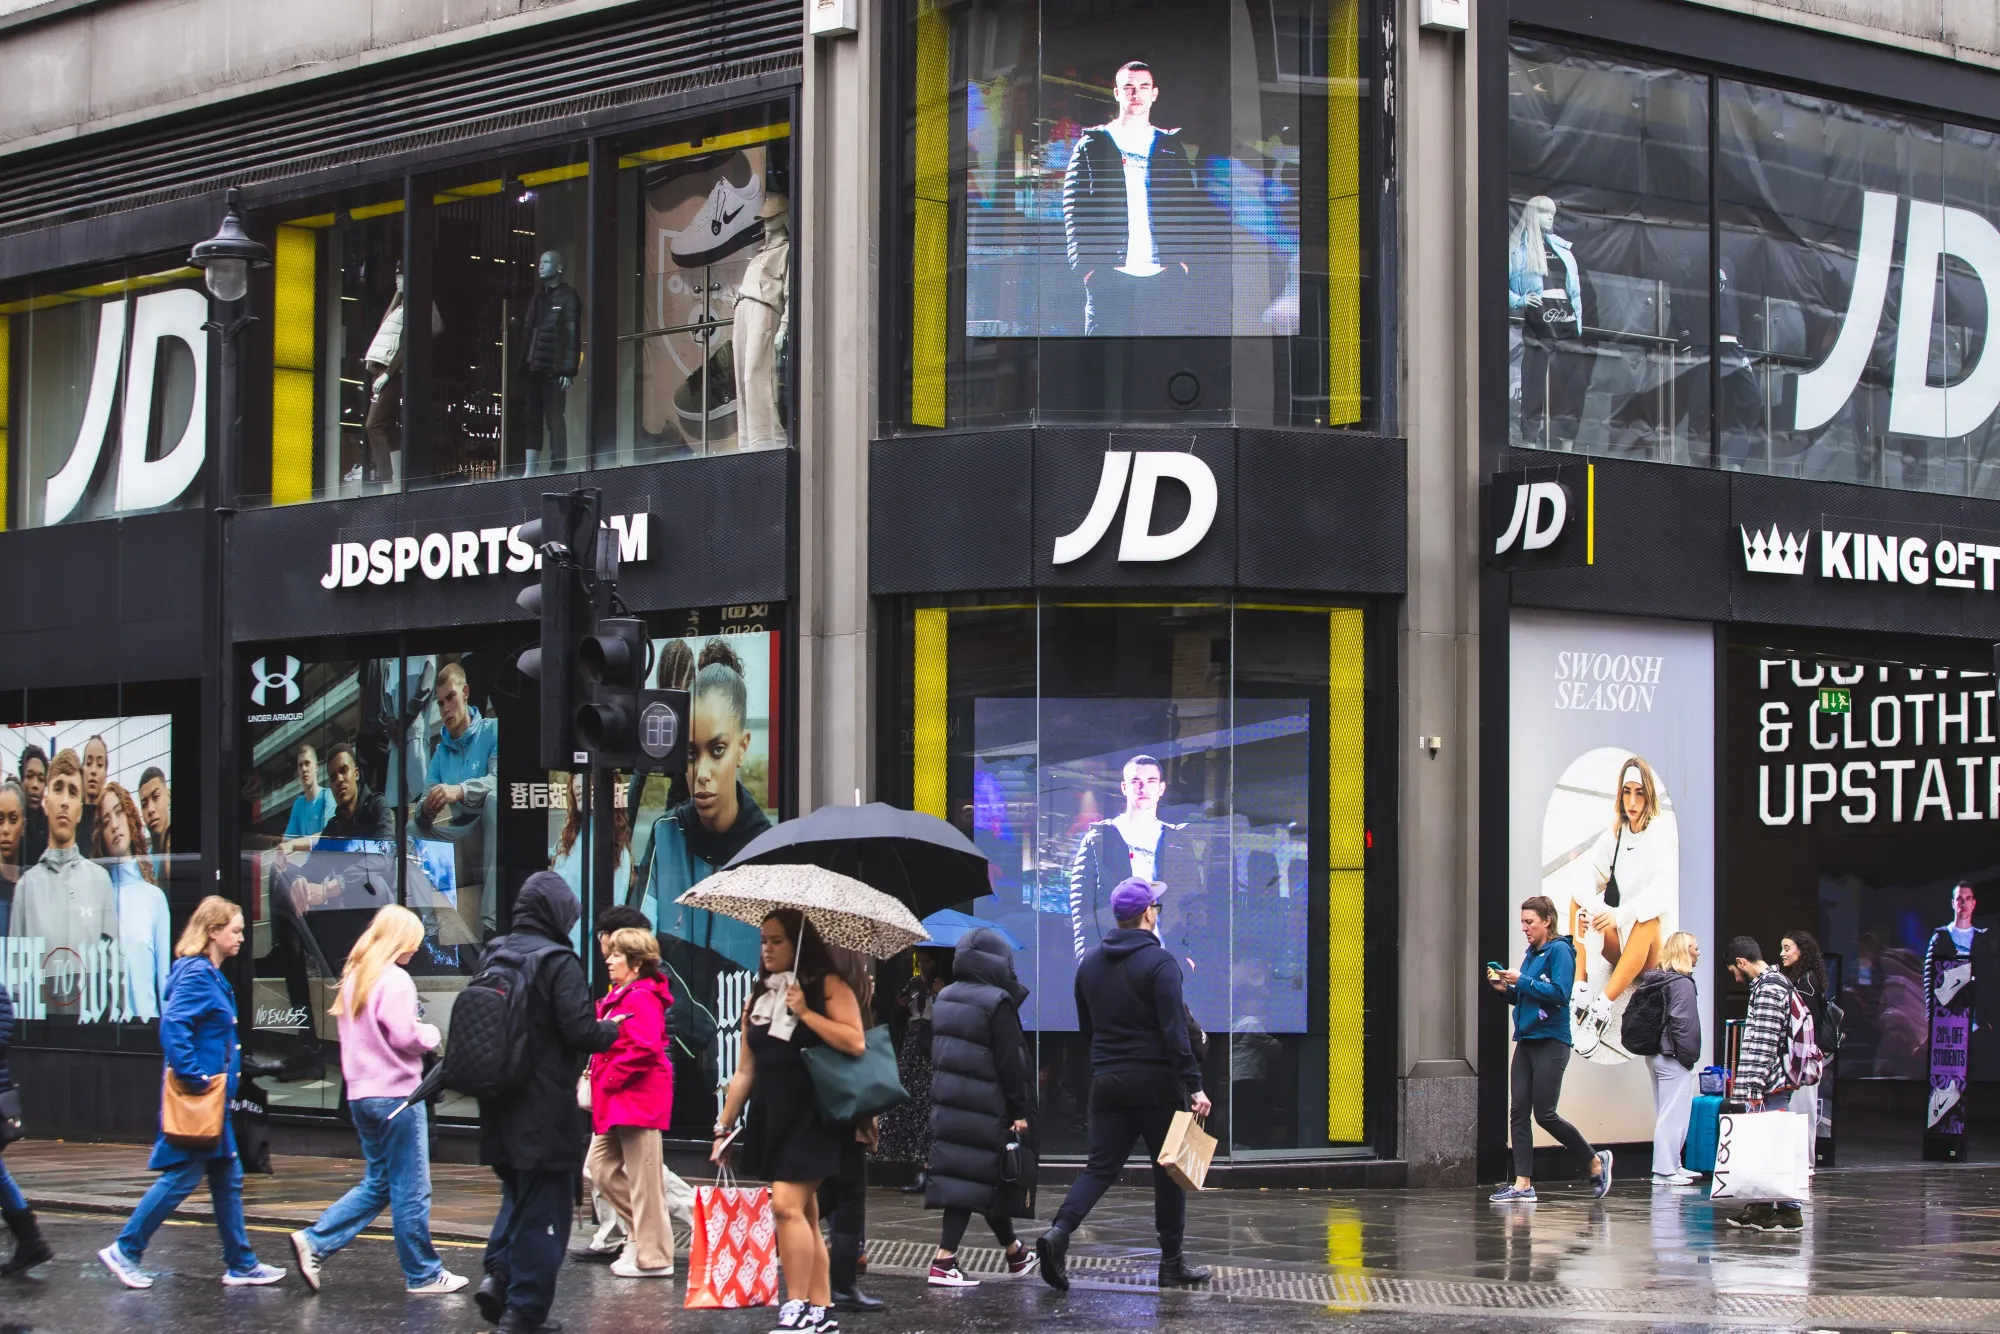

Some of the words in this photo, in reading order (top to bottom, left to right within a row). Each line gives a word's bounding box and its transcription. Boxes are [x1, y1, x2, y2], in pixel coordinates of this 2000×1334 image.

[1795, 191, 2000, 438] JD
[44, 288, 208, 526] JD
[1052, 451, 1218, 564] JD
[1495, 482, 1566, 554] JD
[320, 512, 649, 589] JDSPORTS.M
[1822, 531, 1929, 585] KING
[1935, 540, 1976, 576] OF
[1554, 651, 1664, 683] SWOOSH
[247, 715, 272, 723] UNDER
[272, 713, 304, 721] ARMOUR
[1554, 681, 1656, 712] SEASON
[1760, 702, 1792, 752] &
[0, 937, 47, 1020] ERE
[52, 959, 75, 996] TO
[1933, 1048, 1966, 1068] STUDENTS
[1936, 1026, 1951, 1044] 20%
[1952, 1027, 1964, 1044] OFF
